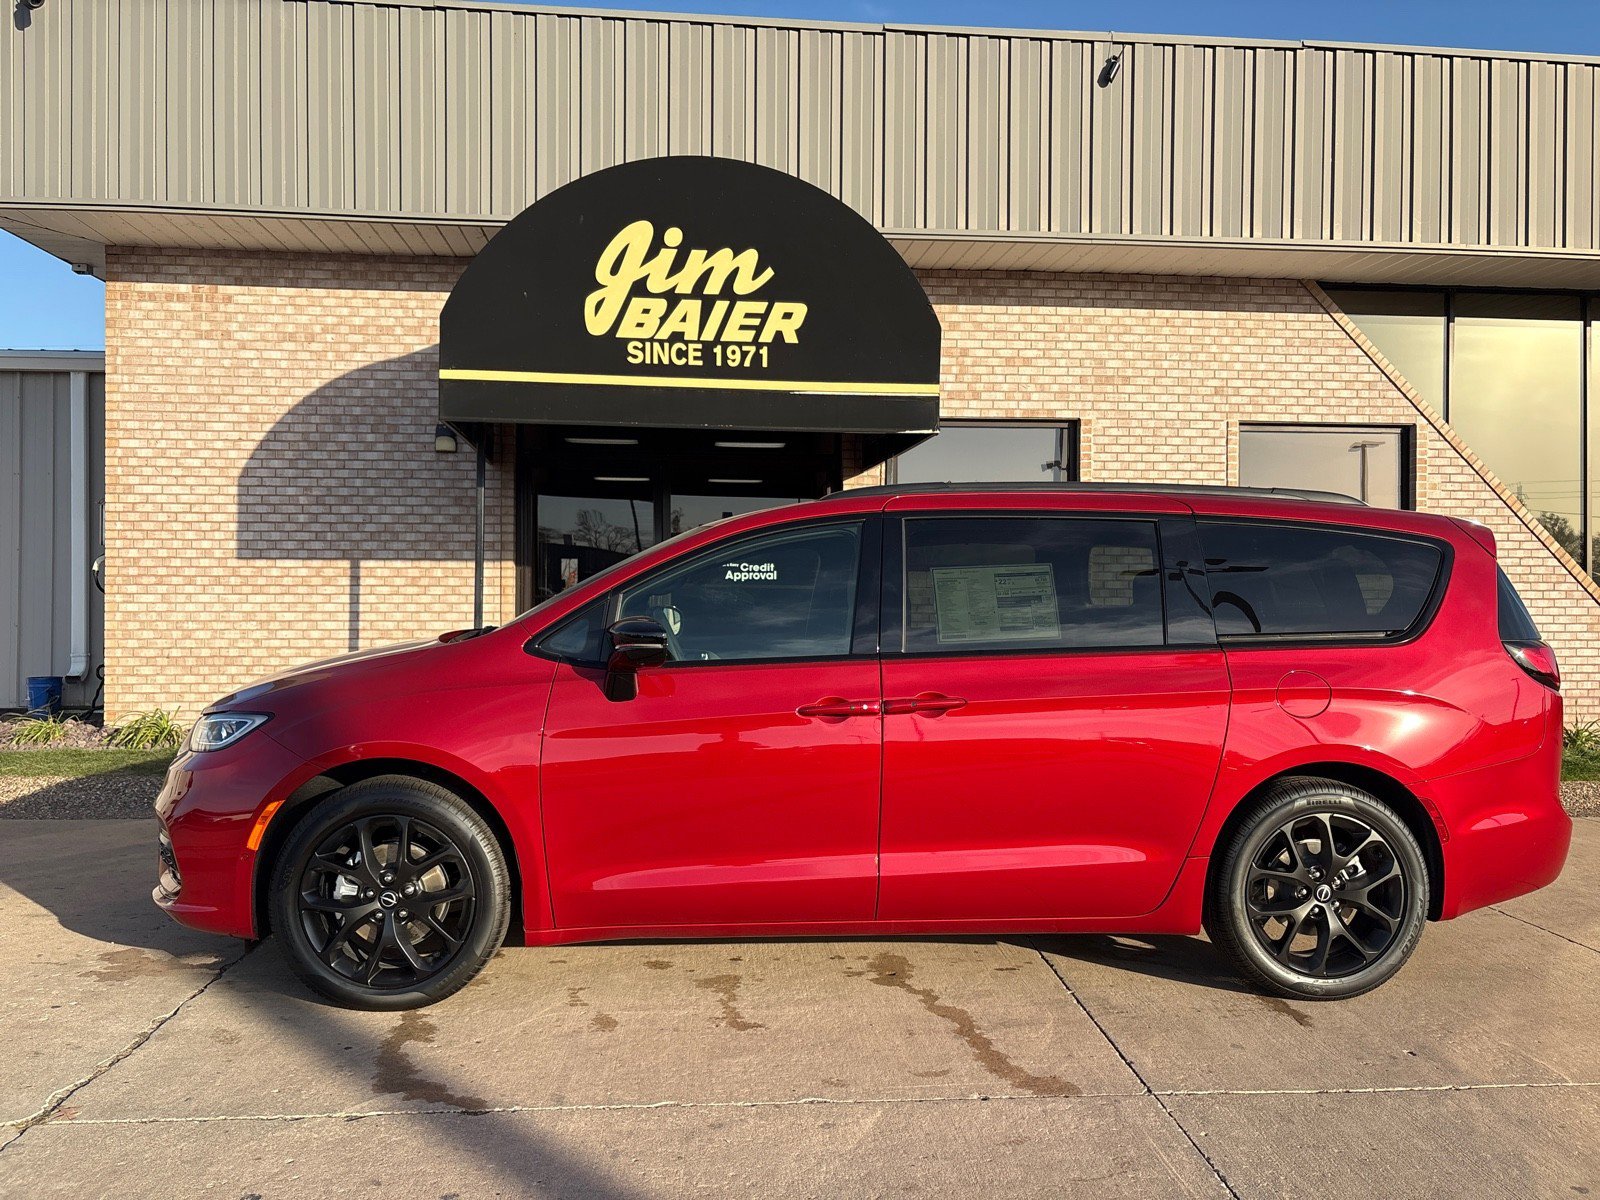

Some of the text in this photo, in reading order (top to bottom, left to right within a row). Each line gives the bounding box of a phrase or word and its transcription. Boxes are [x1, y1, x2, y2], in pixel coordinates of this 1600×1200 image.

[584, 220, 775, 336] Jim
[615, 297, 808, 344] BAIER
[626, 341, 768, 368] SINCE 1971
[725, 570, 777, 582] Approval
[740, 563, 774, 571] Credit
[1306, 798, 1342, 806] PIRELLI
